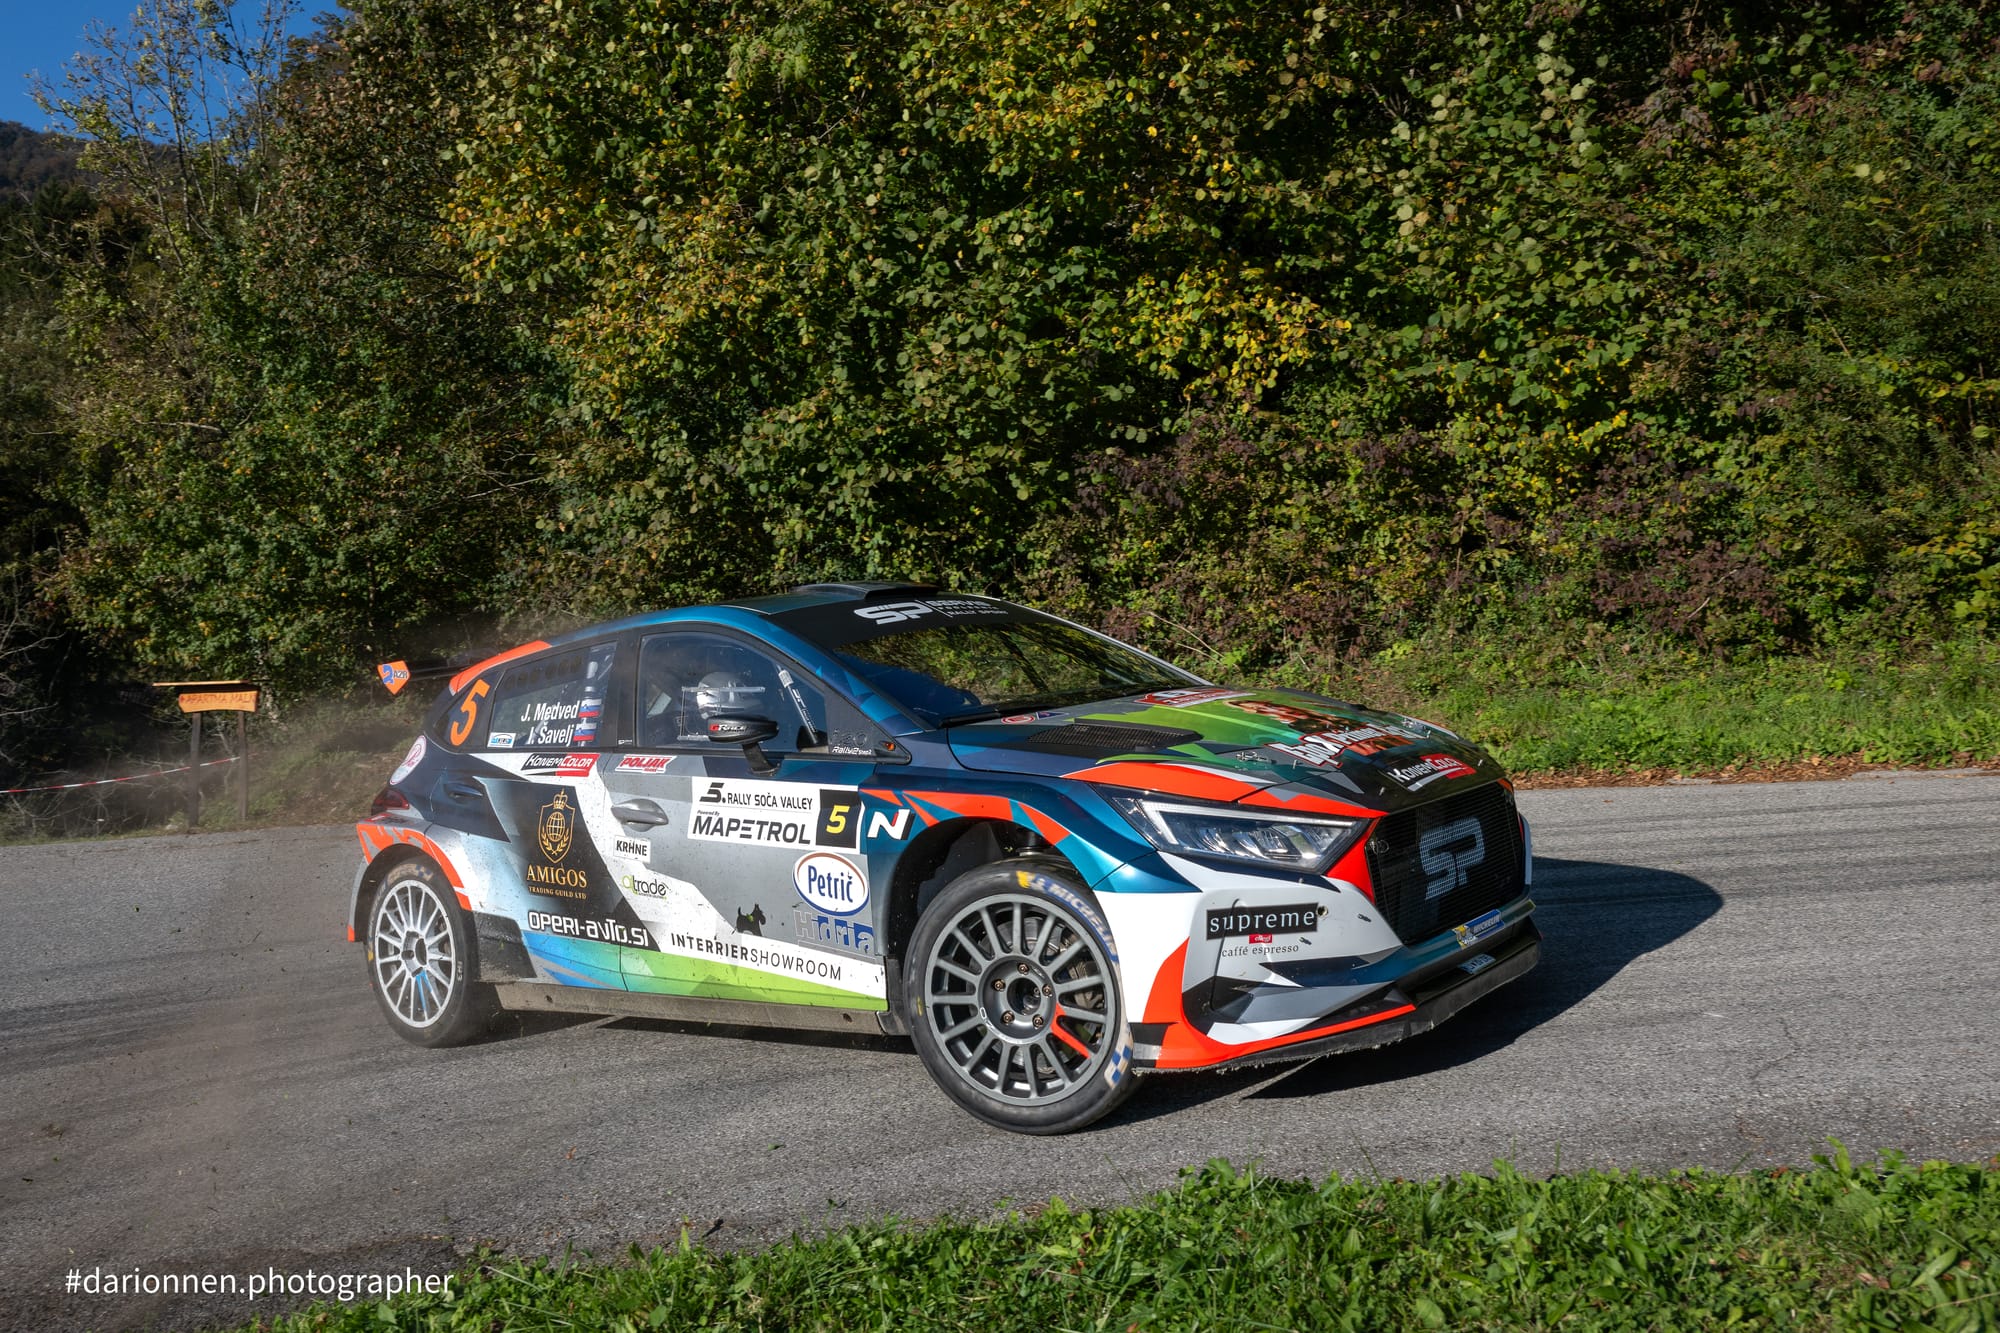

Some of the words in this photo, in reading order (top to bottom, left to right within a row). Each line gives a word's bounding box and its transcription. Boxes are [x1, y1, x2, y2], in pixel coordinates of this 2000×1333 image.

[450, 679, 490, 746] 5
[521, 703, 531, 721] J.
[534, 700, 580, 721] Medved
[526, 726, 535, 745] I.
[538, 721, 574, 747] Šavelj
[620, 757, 671, 768] POLJAK
[699, 782, 727, 804] 5.
[727, 792, 752, 806] RALLY
[754, 792, 778, 808] SOČA
[780, 795, 813, 811] VALLEY
[692, 816, 811, 845] MAPETROL
[826, 805, 850, 834] 5
[616, 840, 648, 856] KRHNE
[527, 864, 587, 888] AMIGOS
[807, 865, 853, 903] Petrič
[529, 886, 554, 896] TRADING
[555, 889, 573, 898] GUILD
[575, 892, 587, 900] LTD
[1210, 911, 1315, 933] supreme
[1252, 945, 1299, 956] espresso
